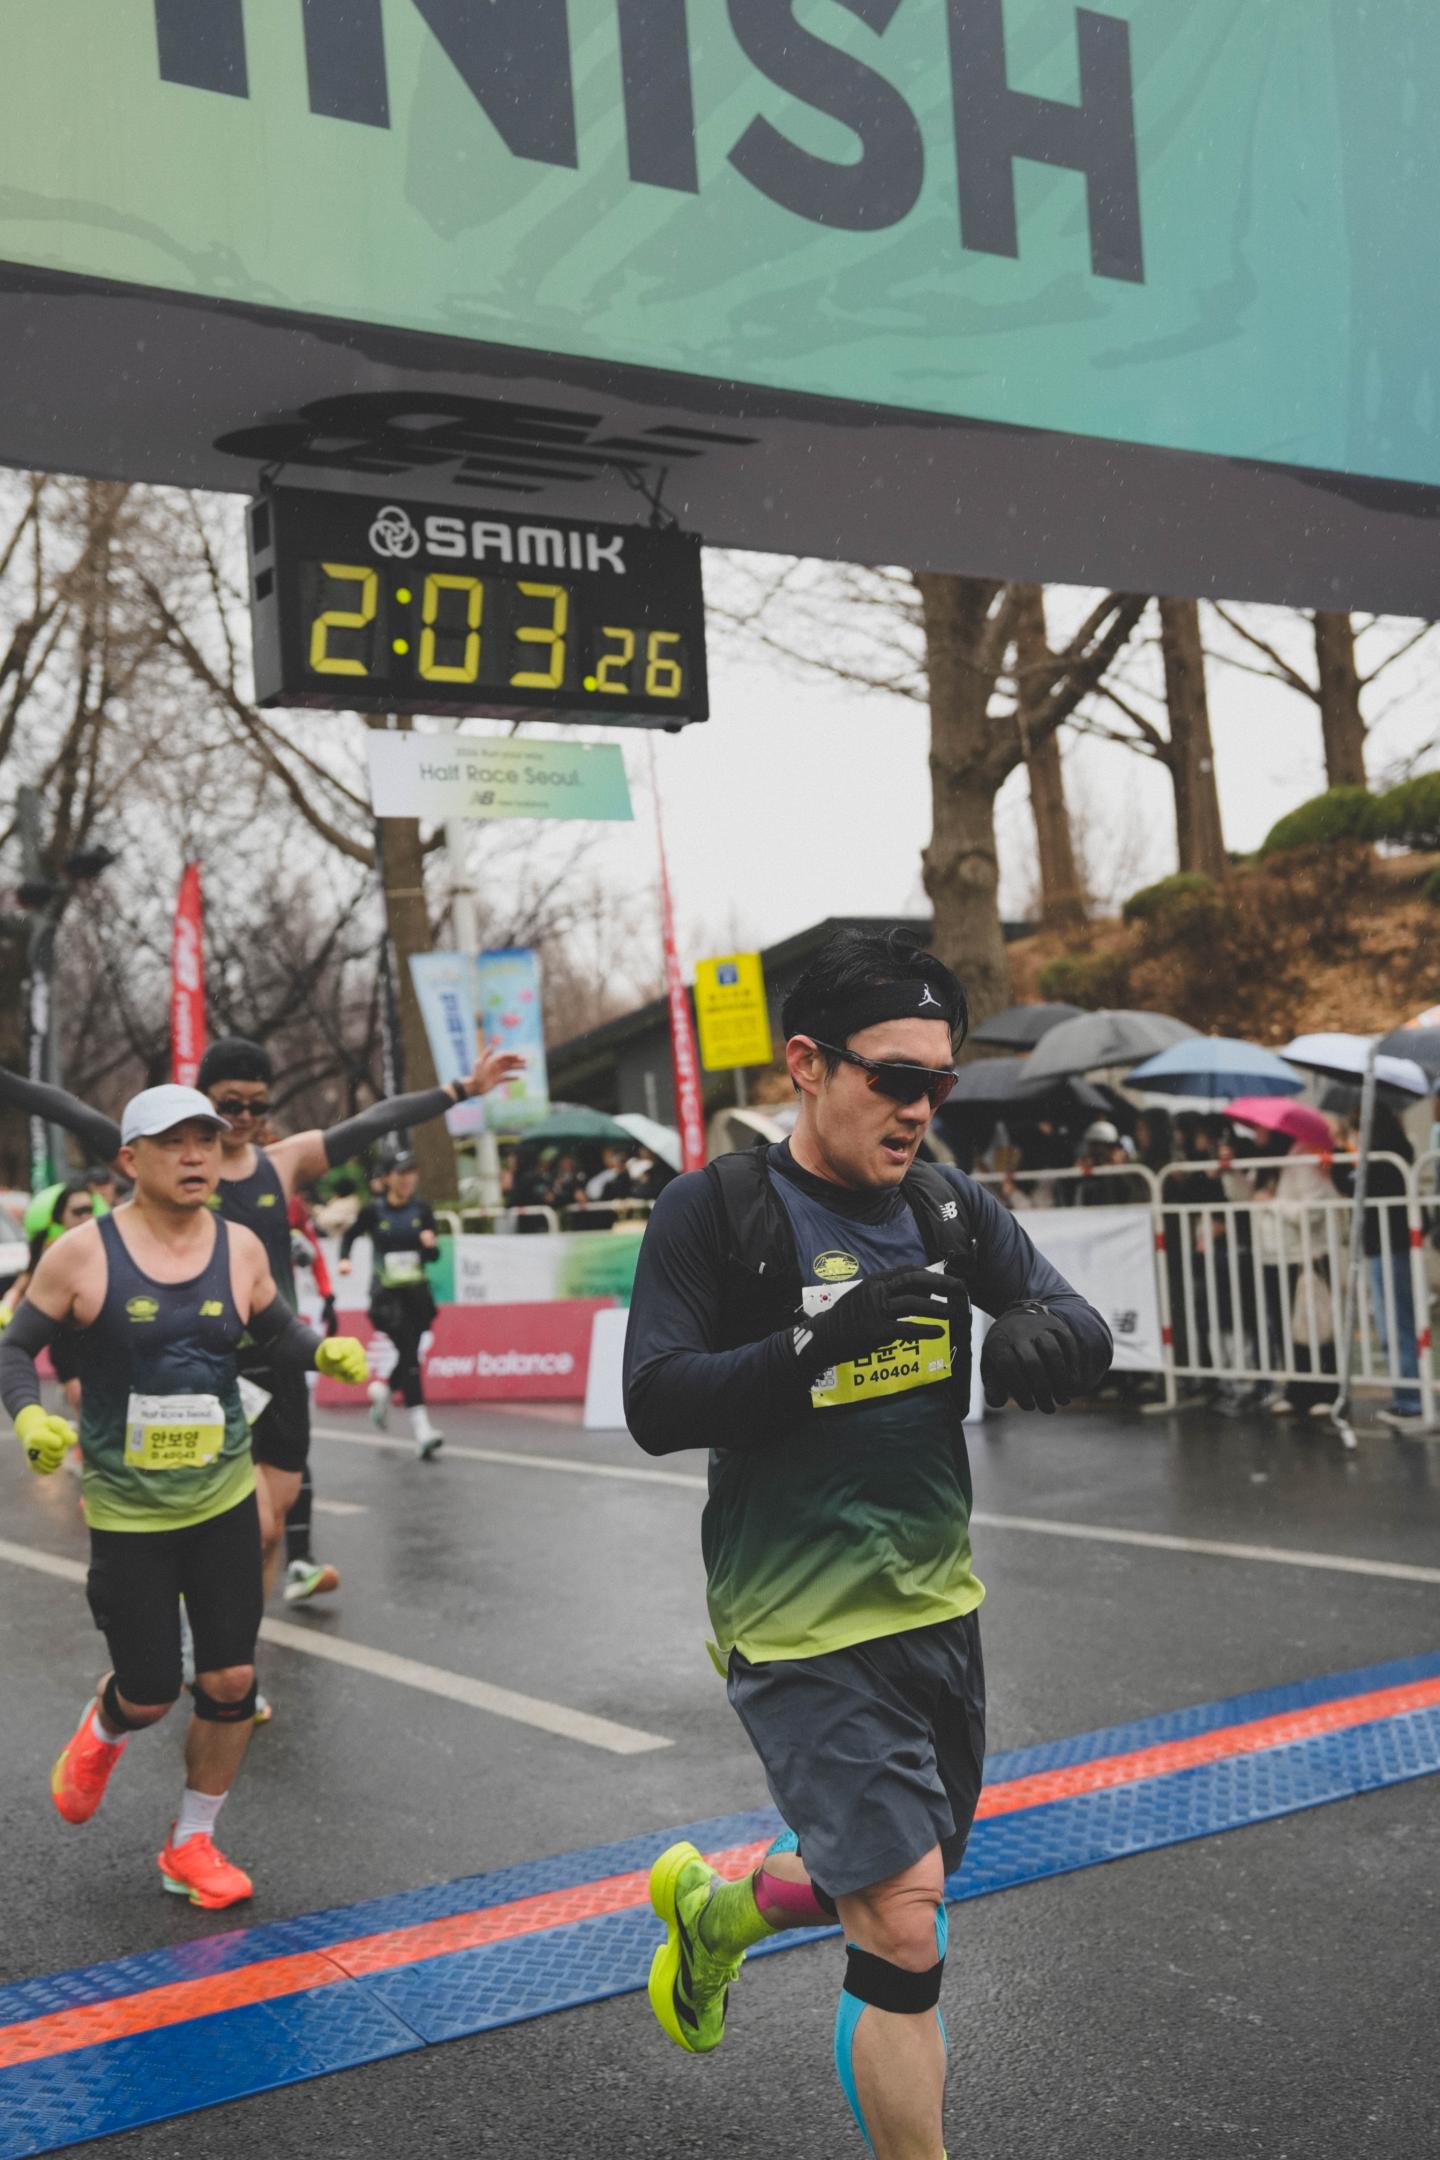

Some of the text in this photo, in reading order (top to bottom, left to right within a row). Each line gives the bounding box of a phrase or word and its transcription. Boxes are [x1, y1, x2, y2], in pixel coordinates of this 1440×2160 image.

[425, 516, 626, 574] SAMIK
[420, 763, 459, 782] Half
[466, 764, 519, 784] Race
[427, 1350, 574, 1377] new balance
[853, 1374, 865, 1387] D
[870, 1361, 920, 1382] 40404
